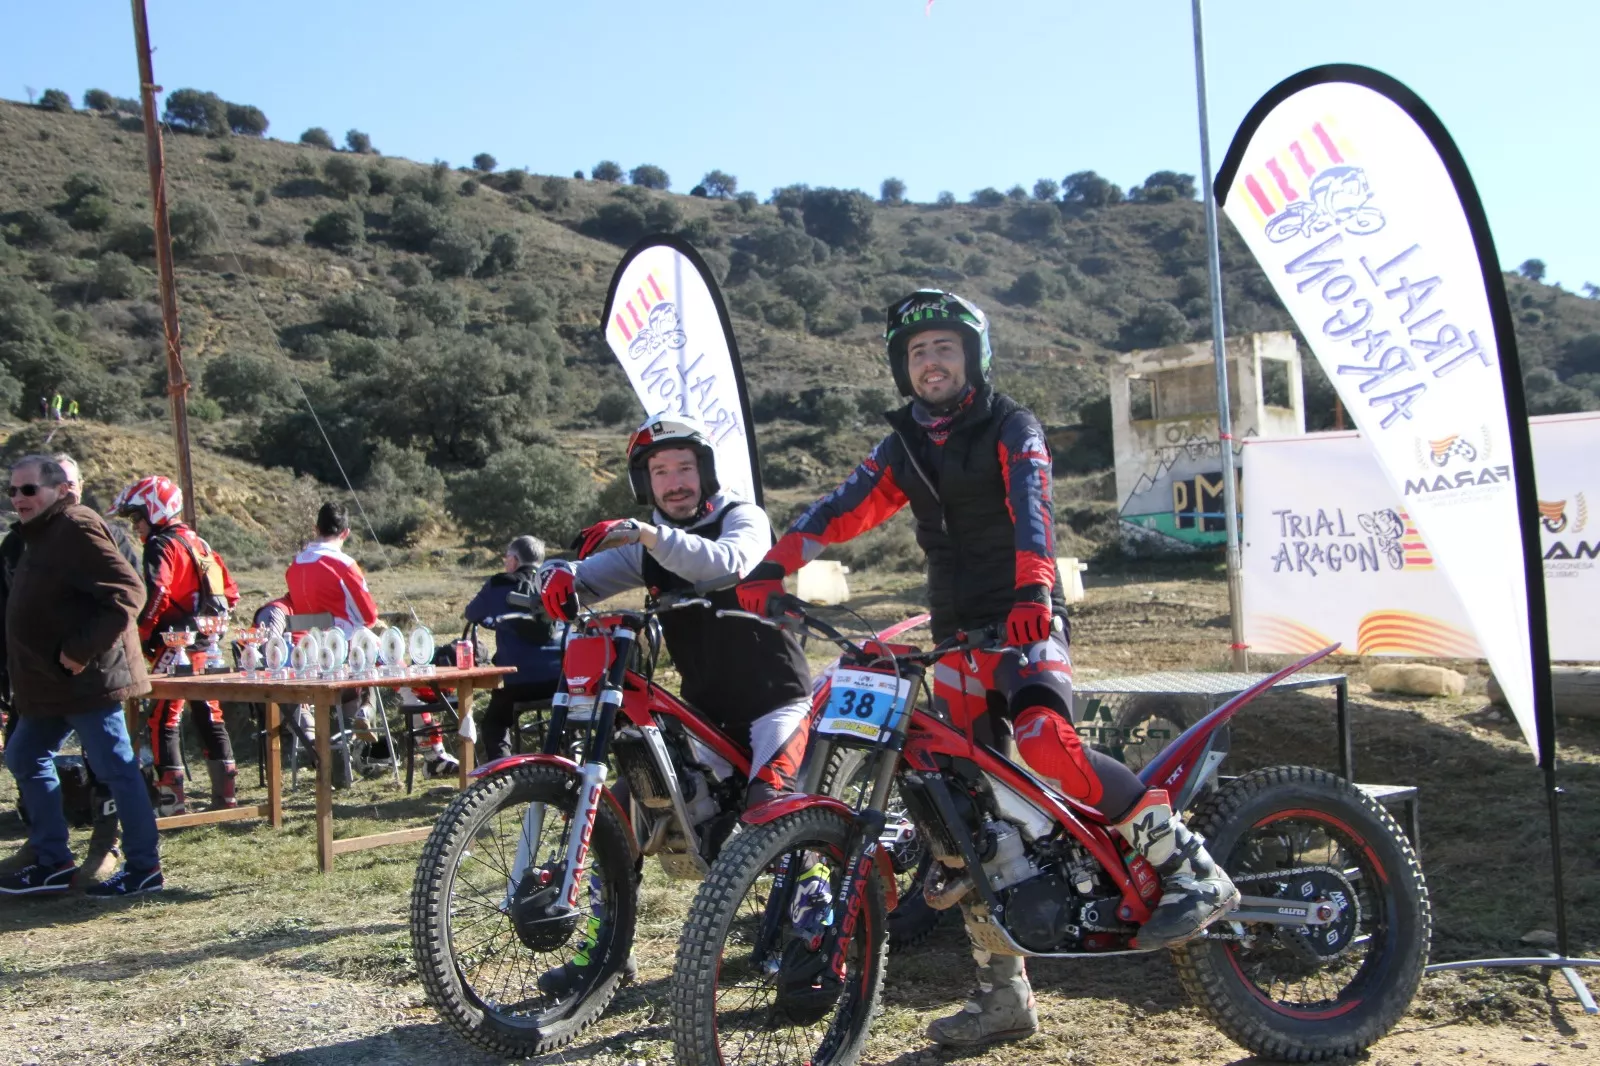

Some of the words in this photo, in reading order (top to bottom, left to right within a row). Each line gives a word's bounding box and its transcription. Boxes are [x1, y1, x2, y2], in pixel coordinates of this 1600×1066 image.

[1272, 508, 1355, 538] TRIAL
[1271, 537, 1379, 577] ARAGON
[838, 689, 875, 719] 38
[1165, 764, 1184, 786] TXT
[567, 785, 602, 908] GASGAS
[832, 856, 872, 983] GASGAS
[1278, 907, 1306, 916] GALFER
